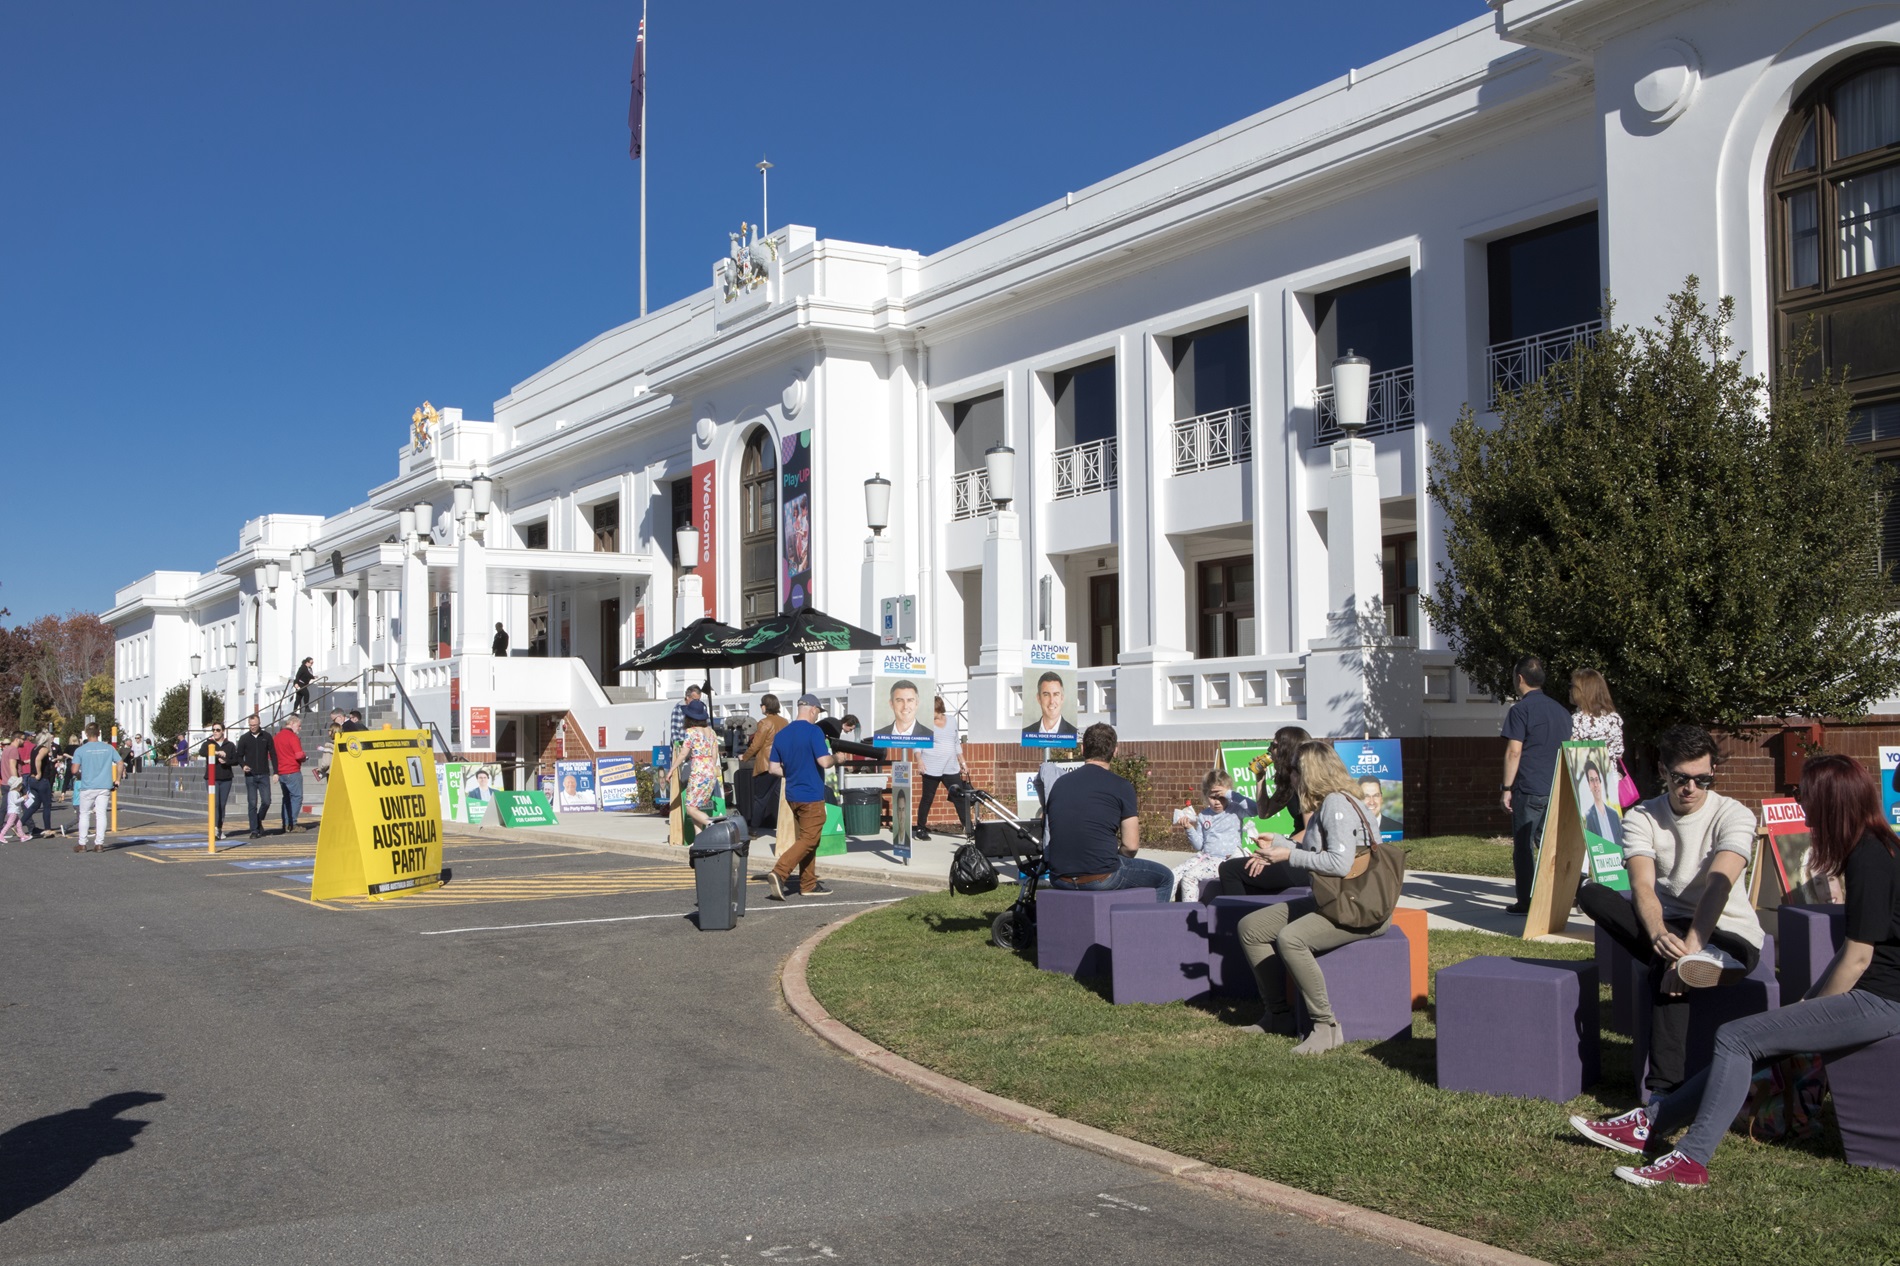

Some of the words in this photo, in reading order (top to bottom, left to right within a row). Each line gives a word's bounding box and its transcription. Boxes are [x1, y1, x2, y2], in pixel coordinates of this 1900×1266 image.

[703, 472, 711, 562] Welcome
[1031, 644, 1069, 653] ANTHONY
[885, 655, 926, 663] ANTHONY
[1357, 755, 1380, 764] ZED
[366, 760, 405, 787] Vote
[411, 759, 420, 783] 1
[1350, 765, 1388, 774] SESELJA
[603, 786, 636, 794] ANTHONY
[512, 795, 532, 805] TIM
[379, 794, 426, 820] UNITED
[511, 806, 543, 816] HOLLO
[1767, 804, 1805, 821] ALICIA
[373, 819, 437, 849] AUSTRALIA
[391, 846, 427, 875] PARTY
[1596, 858, 1606, 868] TIM
[1606, 856, 1621, 868] HOLLO
